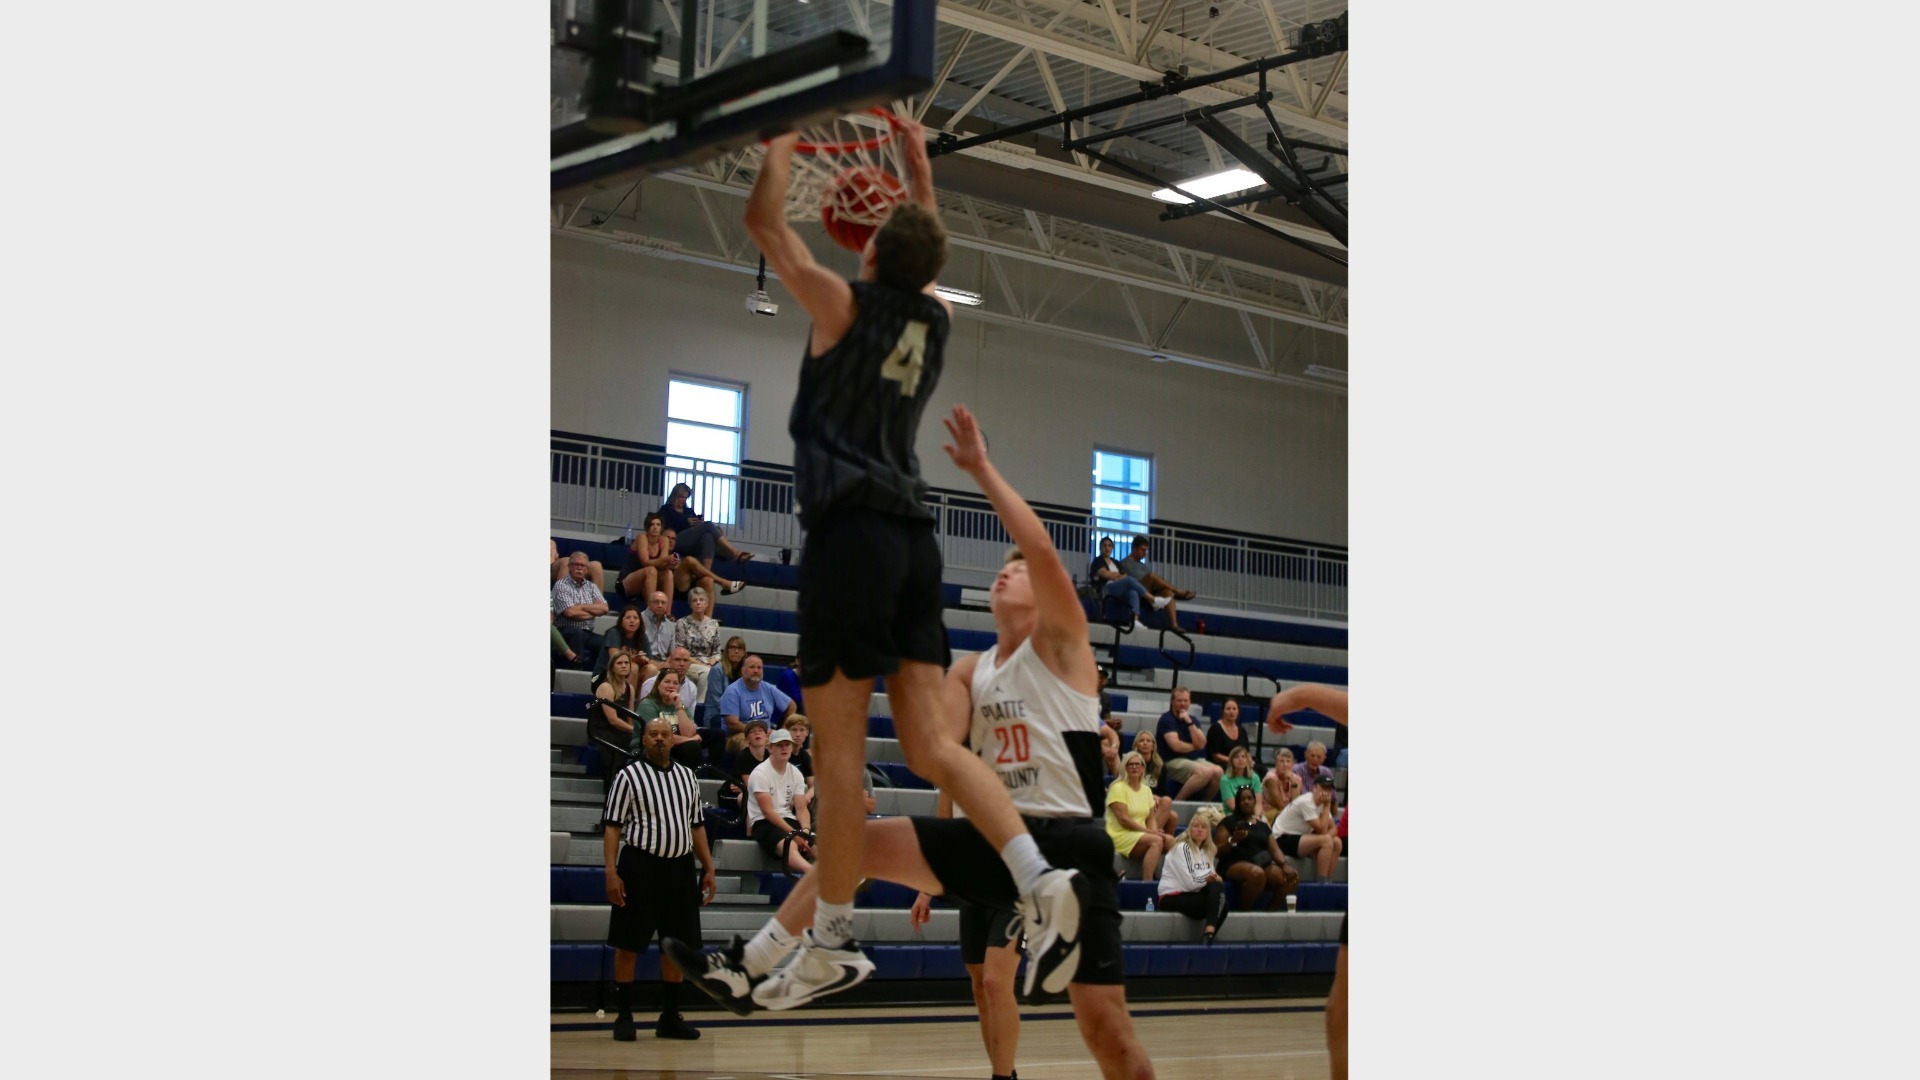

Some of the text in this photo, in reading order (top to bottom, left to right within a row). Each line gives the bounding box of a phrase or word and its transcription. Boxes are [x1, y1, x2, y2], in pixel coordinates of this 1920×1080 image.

[881, 320, 929, 397] 4
[981, 700, 1026, 722] PLATTE
[994, 724, 1030, 764] 20
[996, 766, 1041, 789] OUNTY
